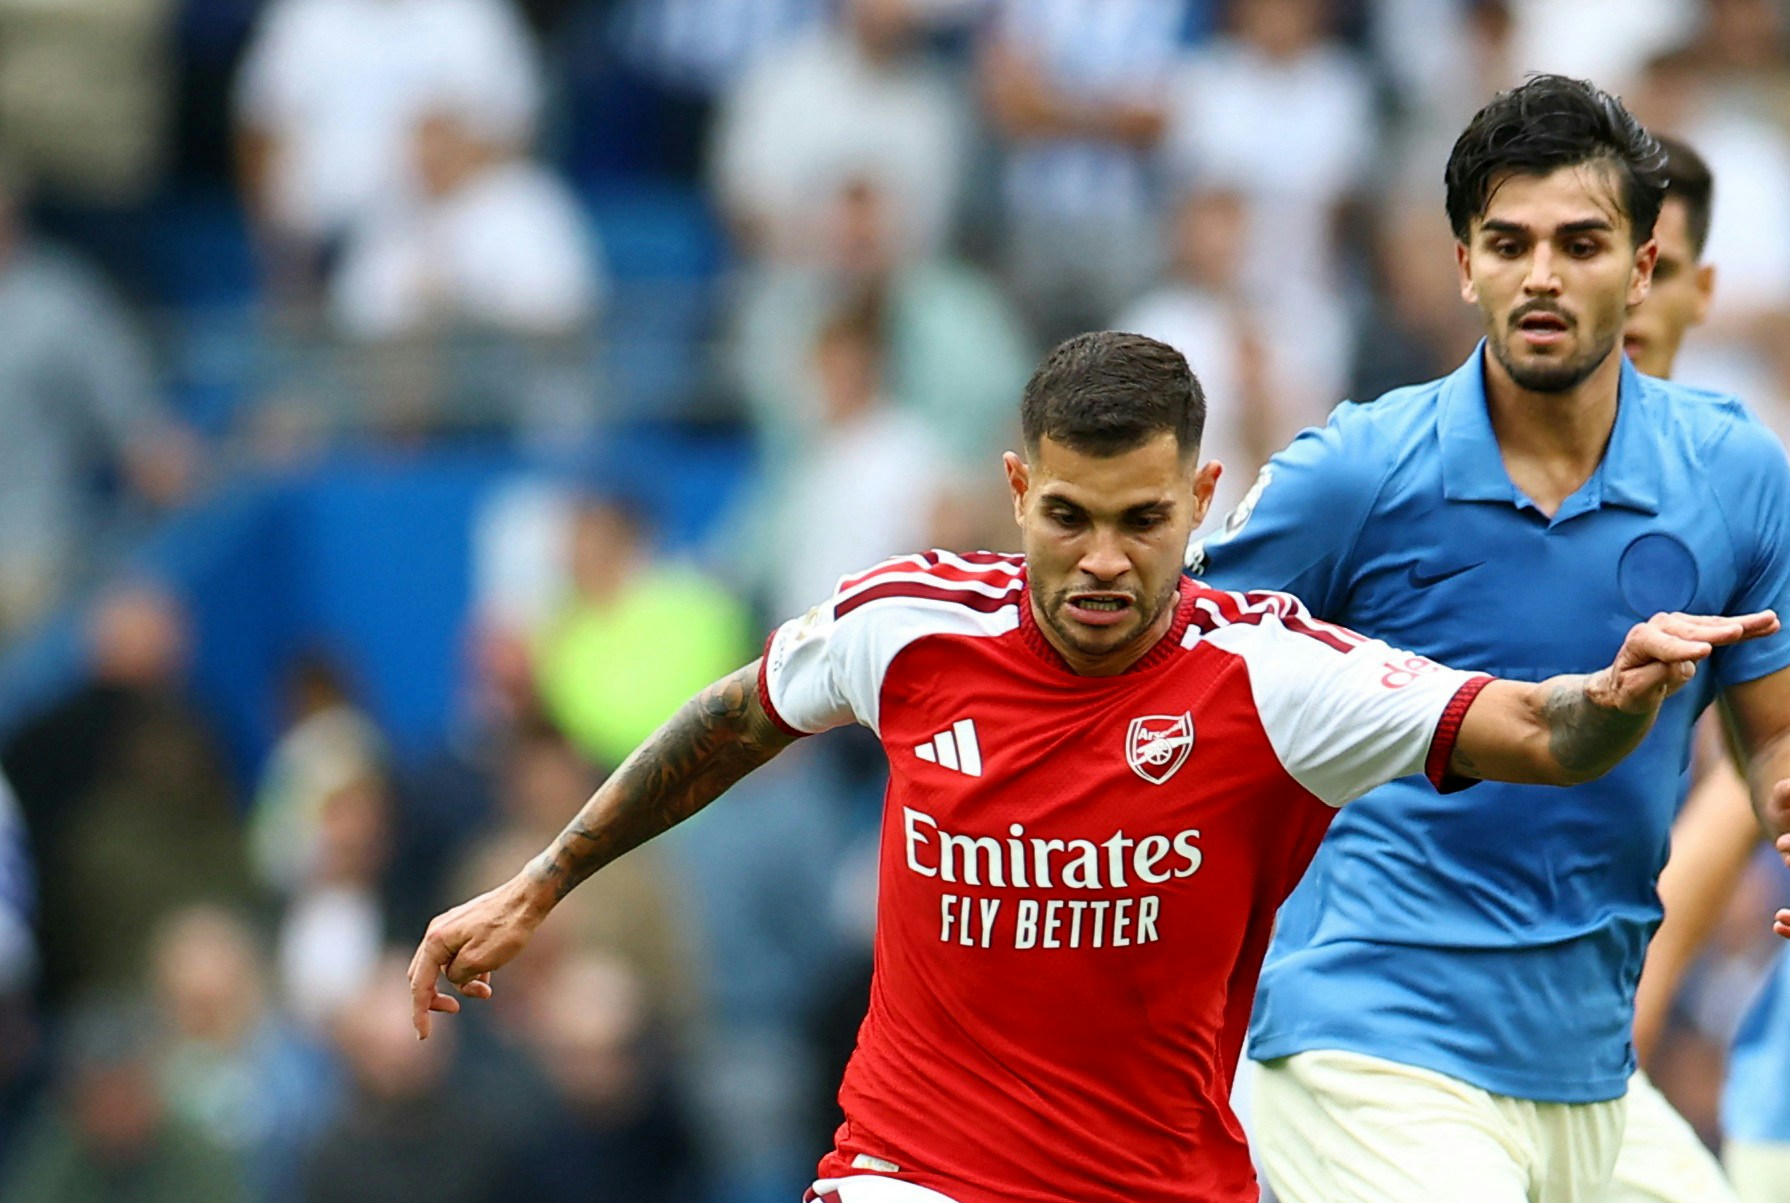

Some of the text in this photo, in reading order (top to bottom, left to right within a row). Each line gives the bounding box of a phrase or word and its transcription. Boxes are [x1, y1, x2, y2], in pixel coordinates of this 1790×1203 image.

[903, 806, 1202, 889] Emirates
[940, 894, 1160, 950] FLY BETTER
